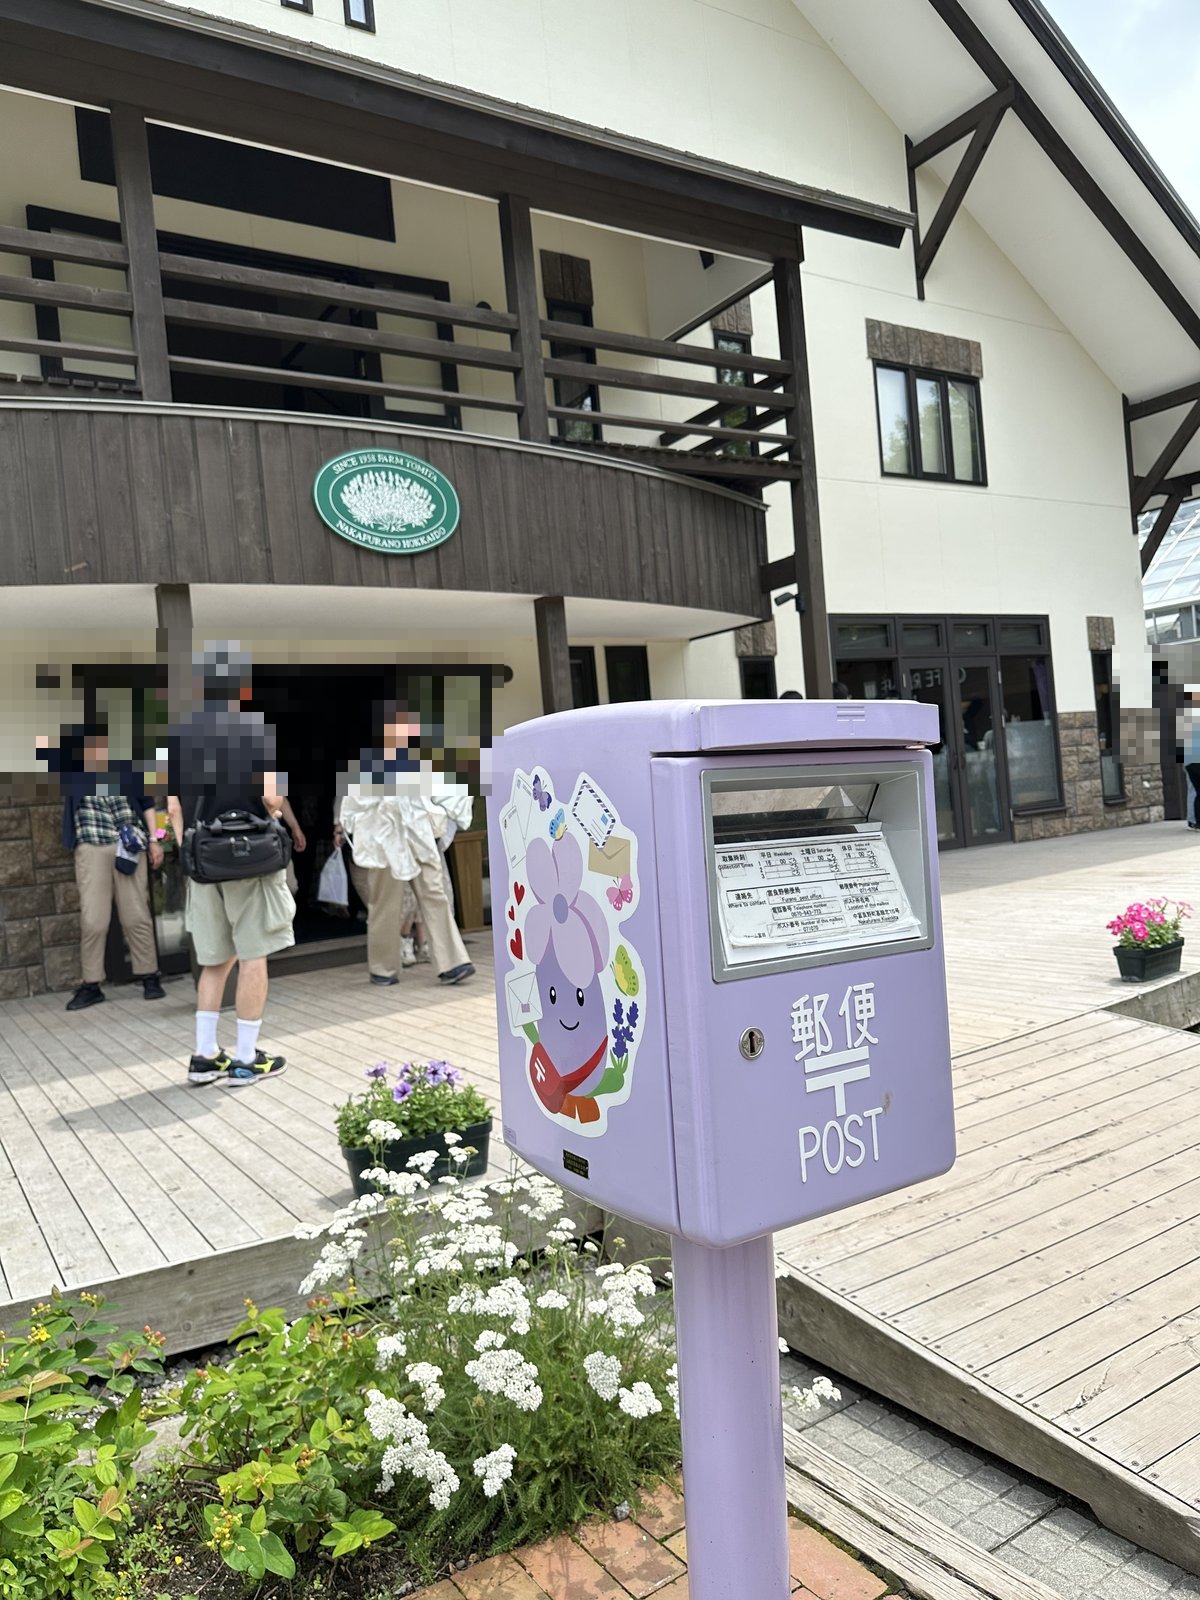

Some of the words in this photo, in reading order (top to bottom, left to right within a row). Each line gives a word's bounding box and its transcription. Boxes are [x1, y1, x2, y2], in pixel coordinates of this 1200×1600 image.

[332, 455, 358, 474] SINCE
[359, 453, 376, 463] 1958
[377, 453, 404, 466] FARM
[405, 460, 438, 483] TOMITA
[335, 519, 401, 549] NAKAFURANO
[402, 526, 446, 549] HOKKAIDO
[791, 982, 879, 1062] 郵便
[798, 1107, 883, 1183] POST
